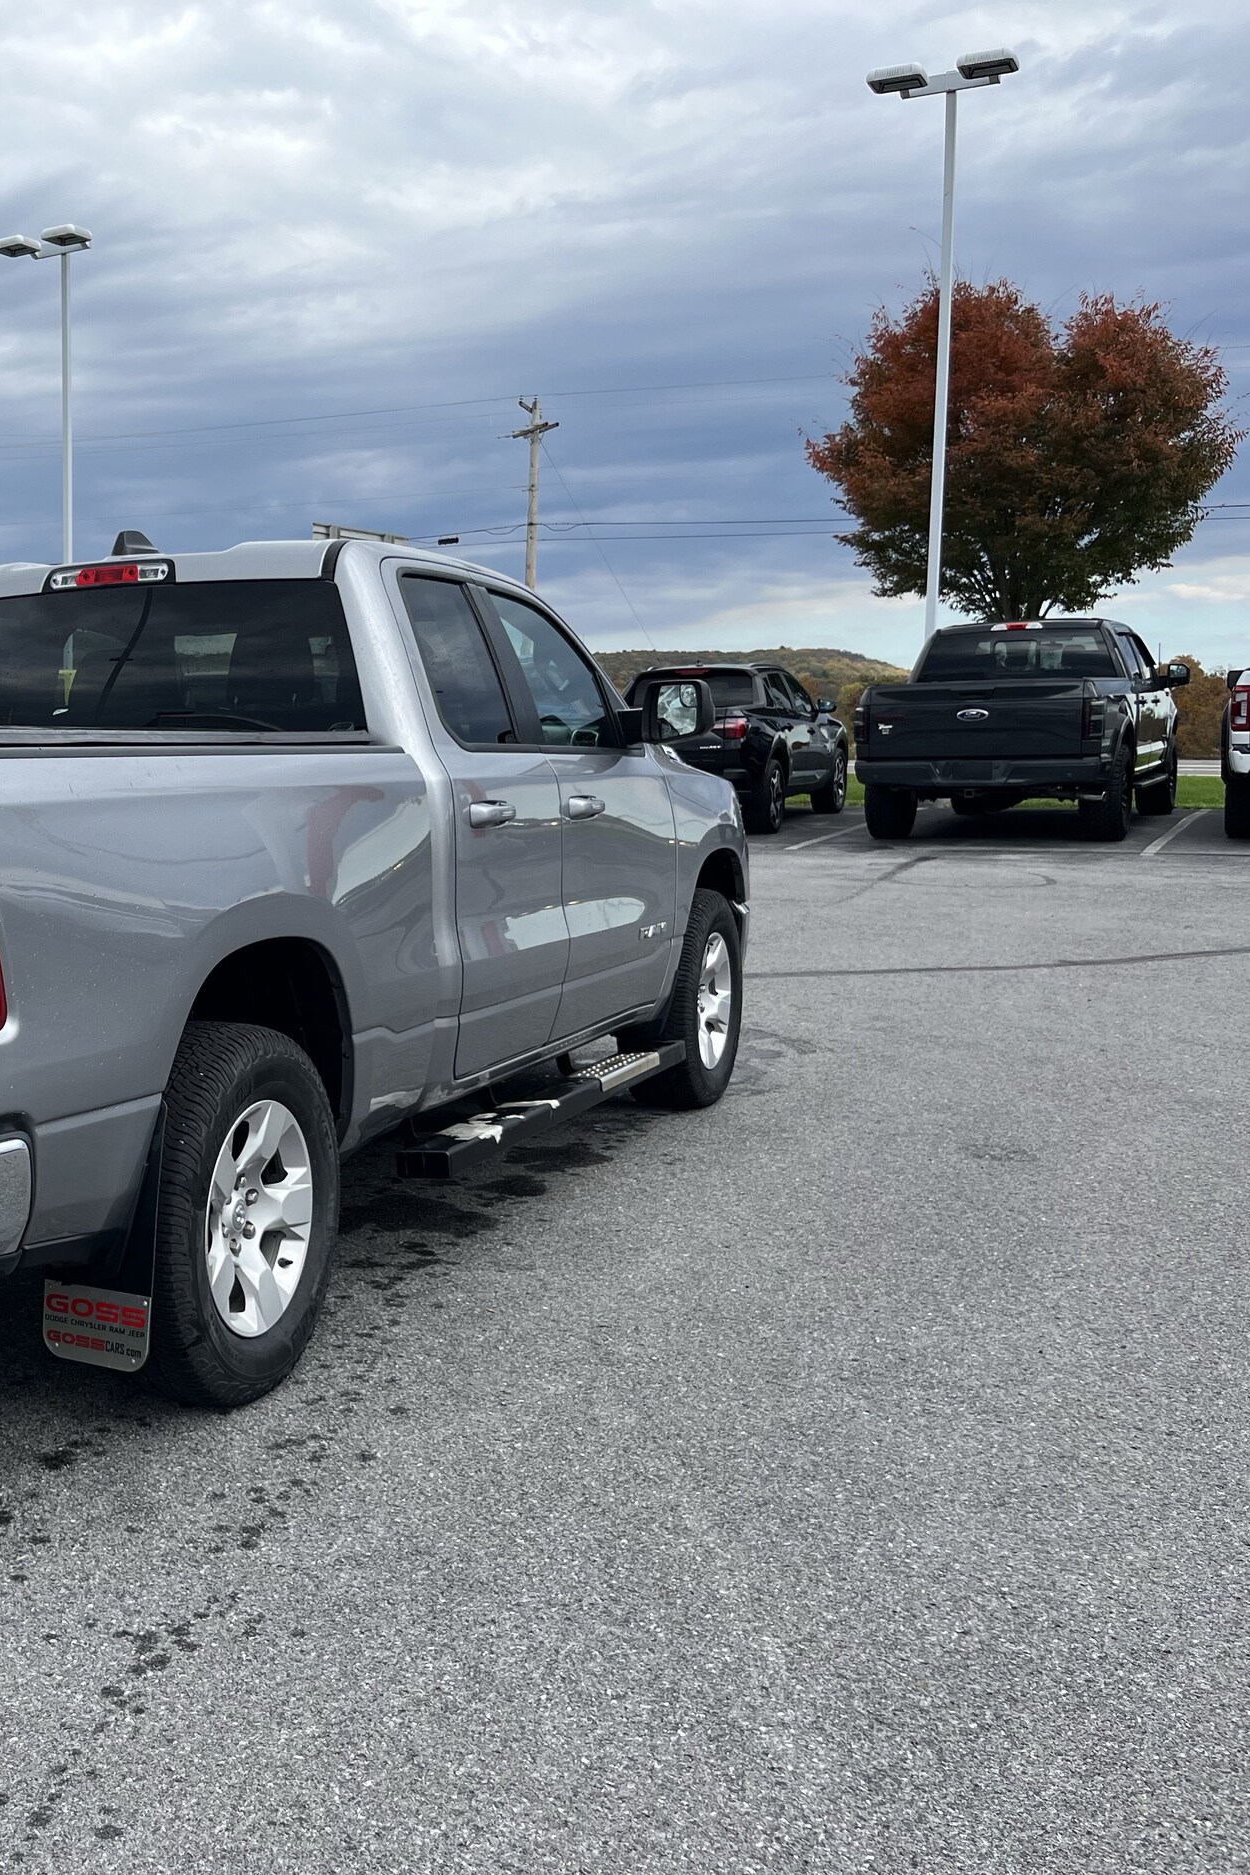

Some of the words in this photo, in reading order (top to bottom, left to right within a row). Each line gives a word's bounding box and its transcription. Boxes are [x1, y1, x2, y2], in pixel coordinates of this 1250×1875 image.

[44, 1313, 68, 1324] DODGE
[71, 1318, 107, 1331] CHRYSLER
[109, 1325, 126, 1335] RAM
[127, 1330, 146, 1338] JEEP
[45, 1293, 147, 1328] GOSS
